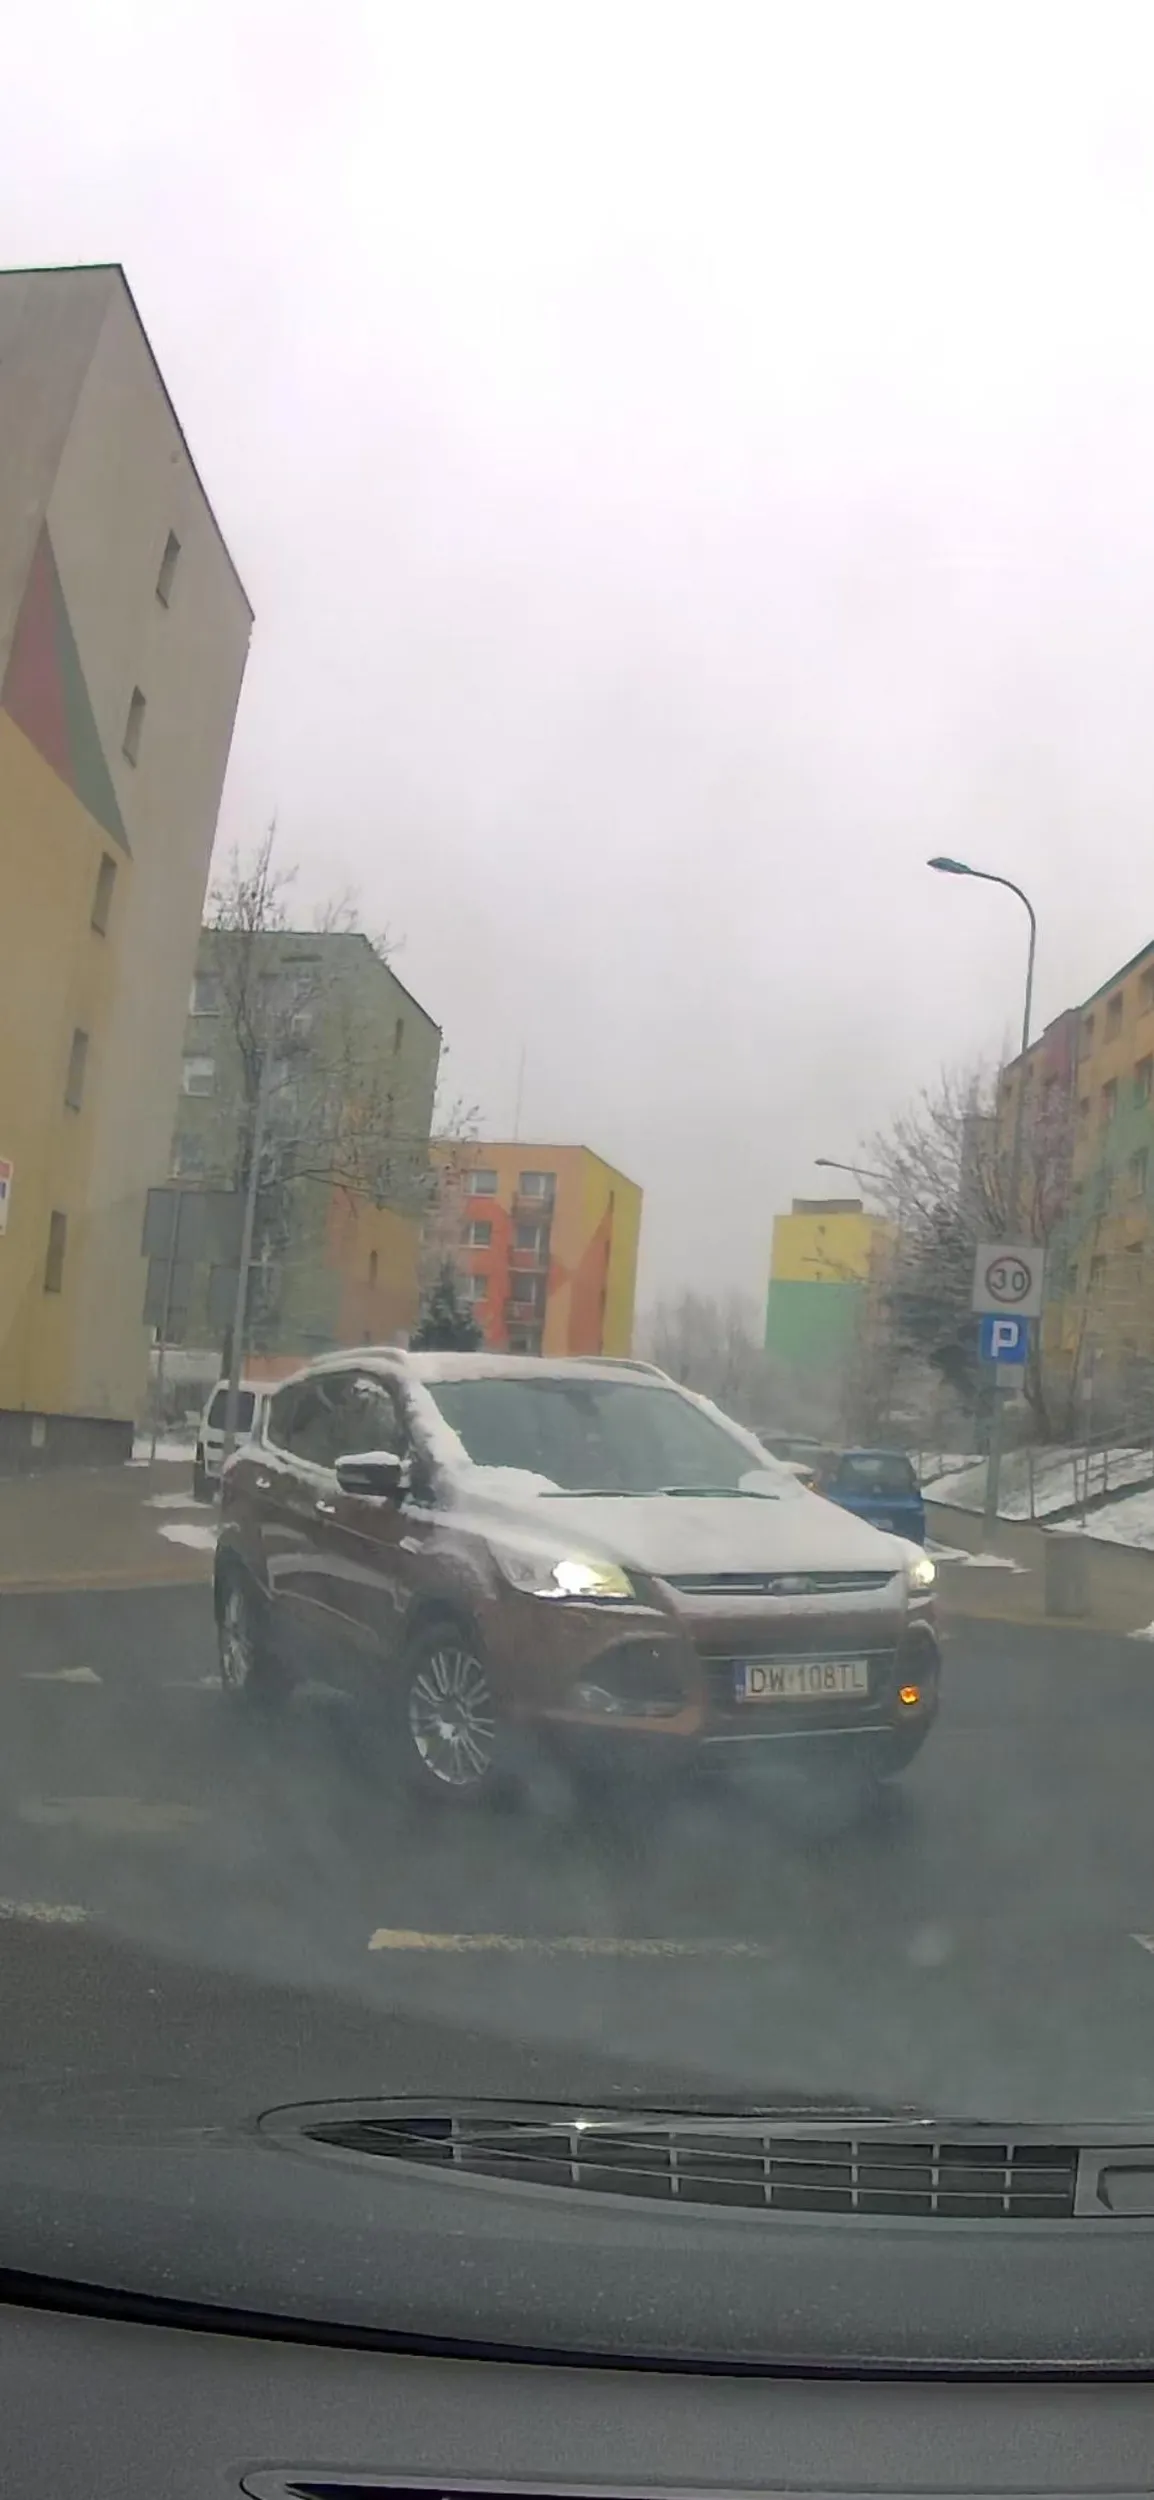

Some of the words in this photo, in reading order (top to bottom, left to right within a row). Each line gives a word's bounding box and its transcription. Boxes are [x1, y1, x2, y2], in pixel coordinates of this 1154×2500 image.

[991, 1267, 1026, 1292] 30
[990, 1320, 1019, 1358] P
[750, 1667, 785, 1693] DW
[797, 1663, 864, 1692] 108TL
